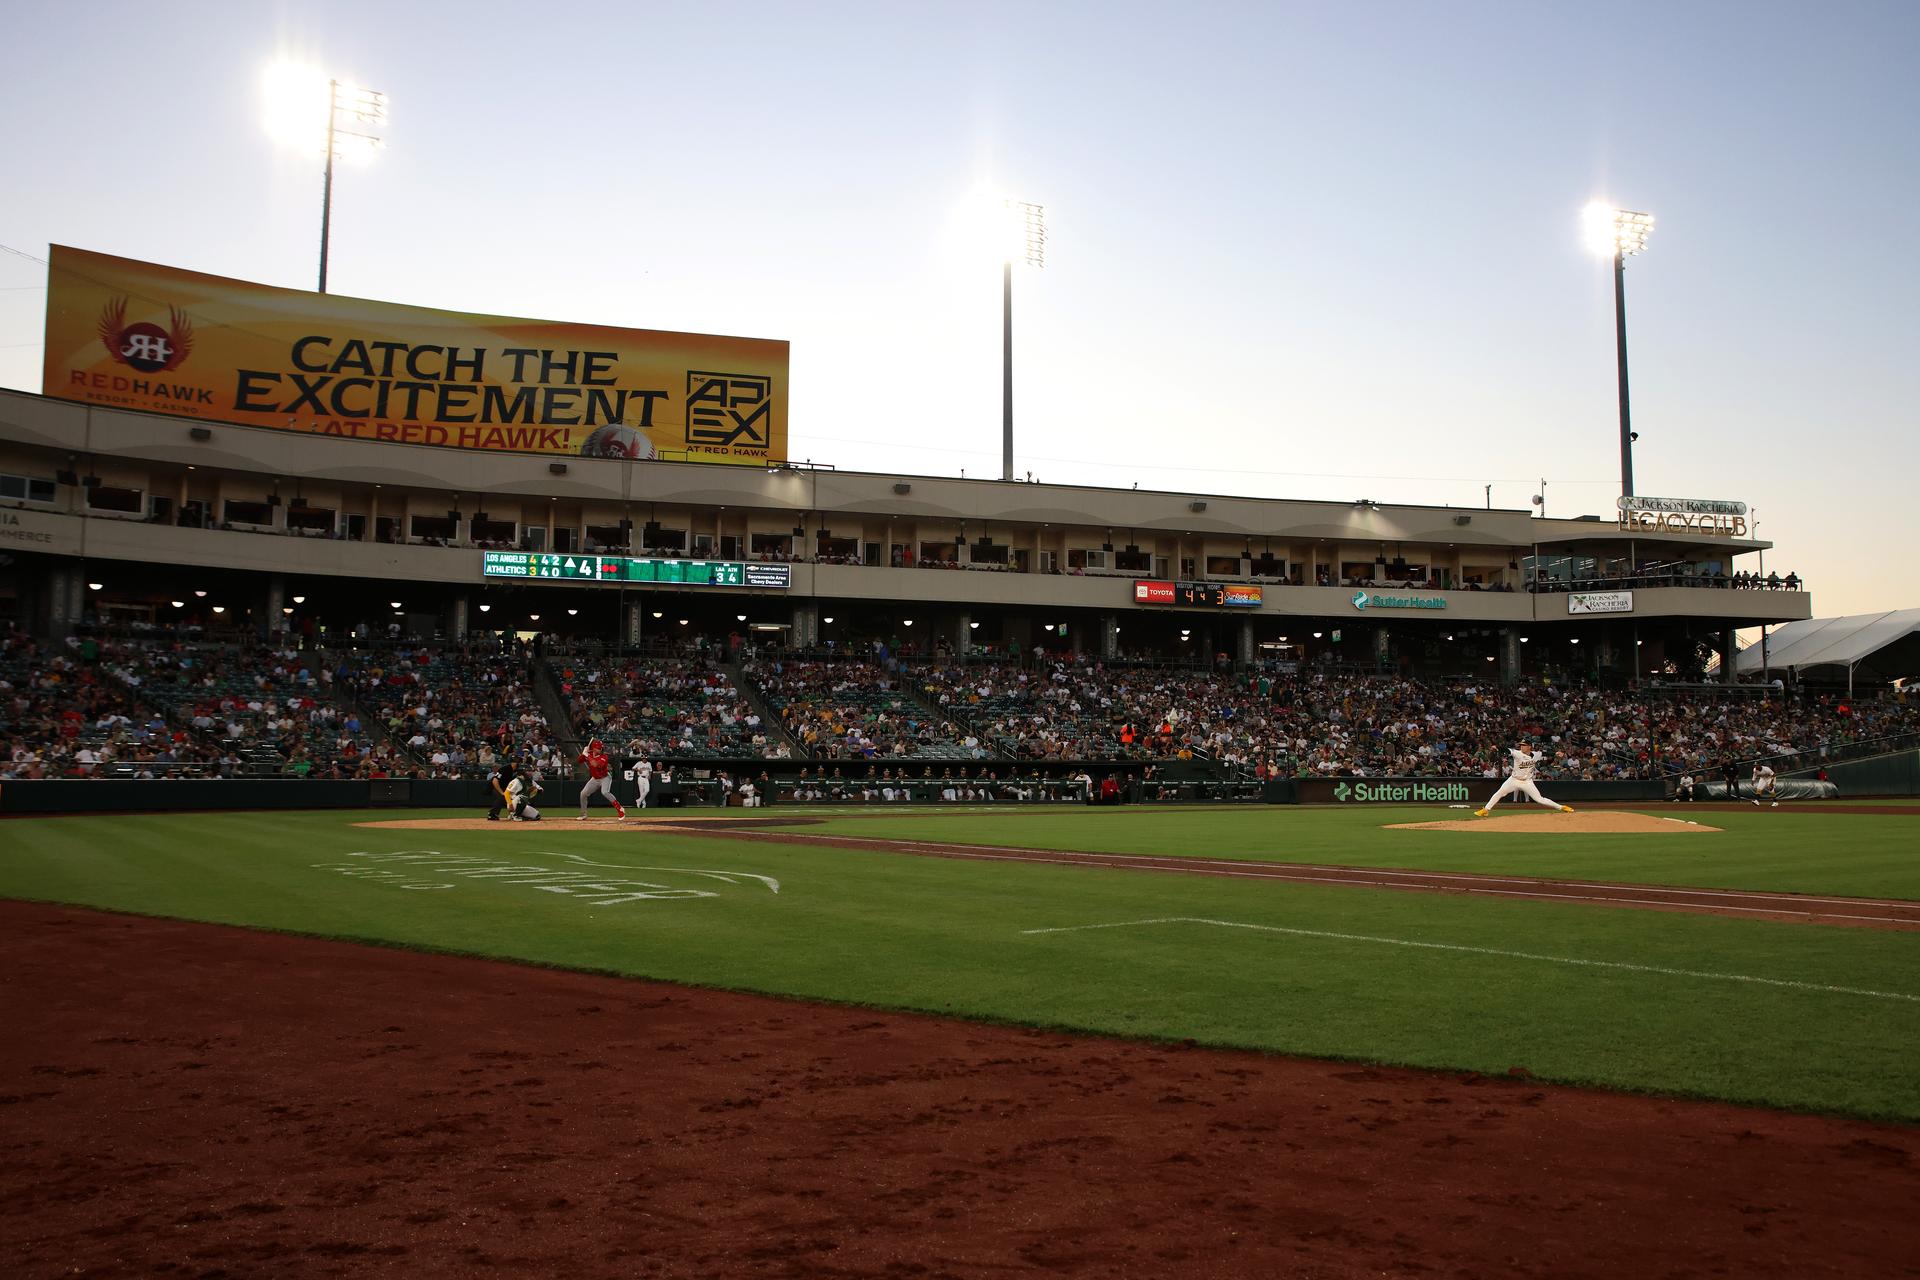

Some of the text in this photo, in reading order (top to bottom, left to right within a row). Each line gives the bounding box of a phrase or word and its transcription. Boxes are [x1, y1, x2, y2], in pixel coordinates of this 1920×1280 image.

[291, 336, 619, 386] CATCH THE
[87, 392, 199, 413] RESORT CASINO
[232, 369, 670, 427] EXCITEMENT
[323, 420, 571, 449] AT RED HAWK!
[704, 446, 729, 454] RED
[734, 448, 768, 457] HAWK
[1618, 511, 1747, 537] LEGACY CLUB
[486, 554, 560, 565] LOS ANGELES 4 4 2
[579, 560, 592, 576] 4
[486, 565, 560, 577] ATHLETICS 3 4 0
[716, 573, 736, 583] 3 4
[1186, 591, 1194, 602] 4
[1216, 591, 1224, 605] 3
[1372, 595, 1447, 608] Sutter Health
[1354, 783, 1469, 801] Sutter Health
[434, 866, 722, 905] RIVER
